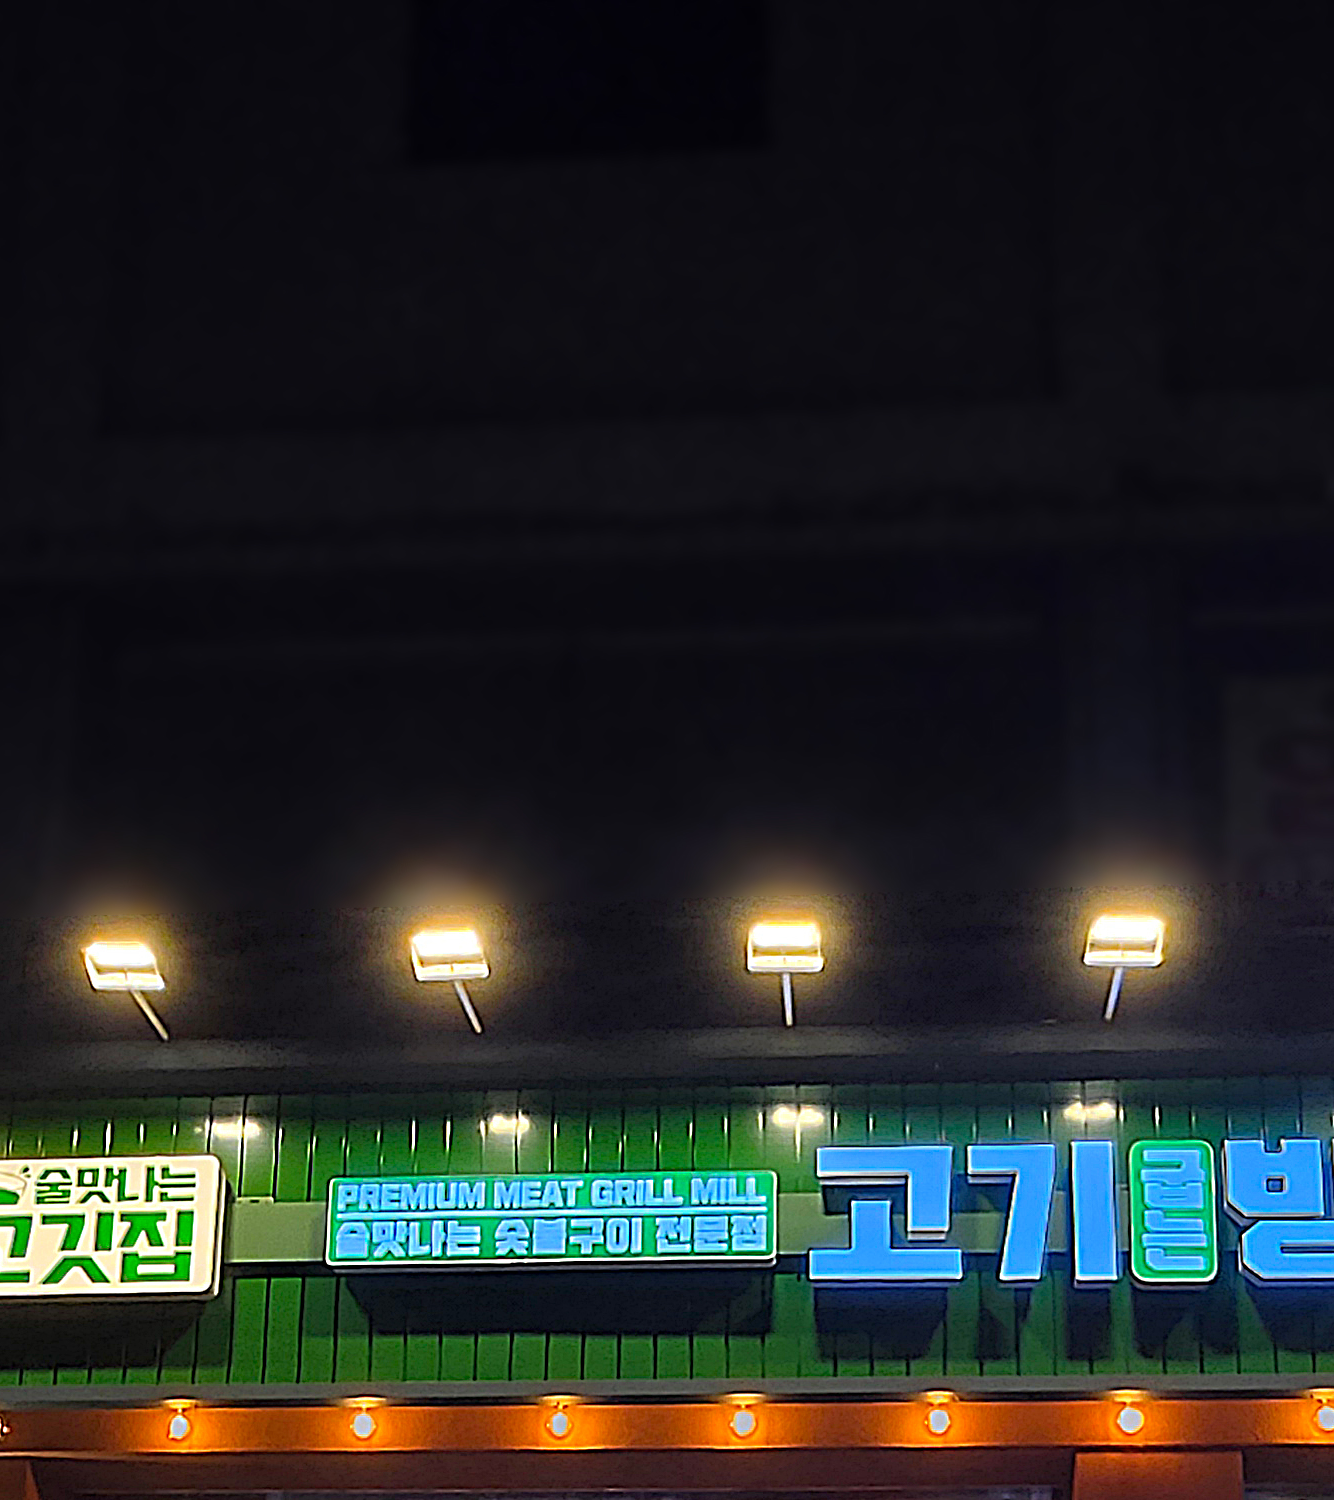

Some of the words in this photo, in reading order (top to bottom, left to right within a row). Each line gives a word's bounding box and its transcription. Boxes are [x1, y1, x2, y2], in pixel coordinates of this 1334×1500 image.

[34, 1165, 197, 1205] 술맛나는
[337, 1181, 485, 1211] PREMIUM
[494, 1180, 582, 1209] MEAT
[591, 1178, 684, 1207] GRILL
[691, 1176, 767, 1206] MILL
[808, 1139, 1117, 1284] 고기
[336, 1220, 481, 1259] 술맛나는
[494, 1216, 643, 1257] 숯불구이
[655, 1214, 767, 1255] 전문점
